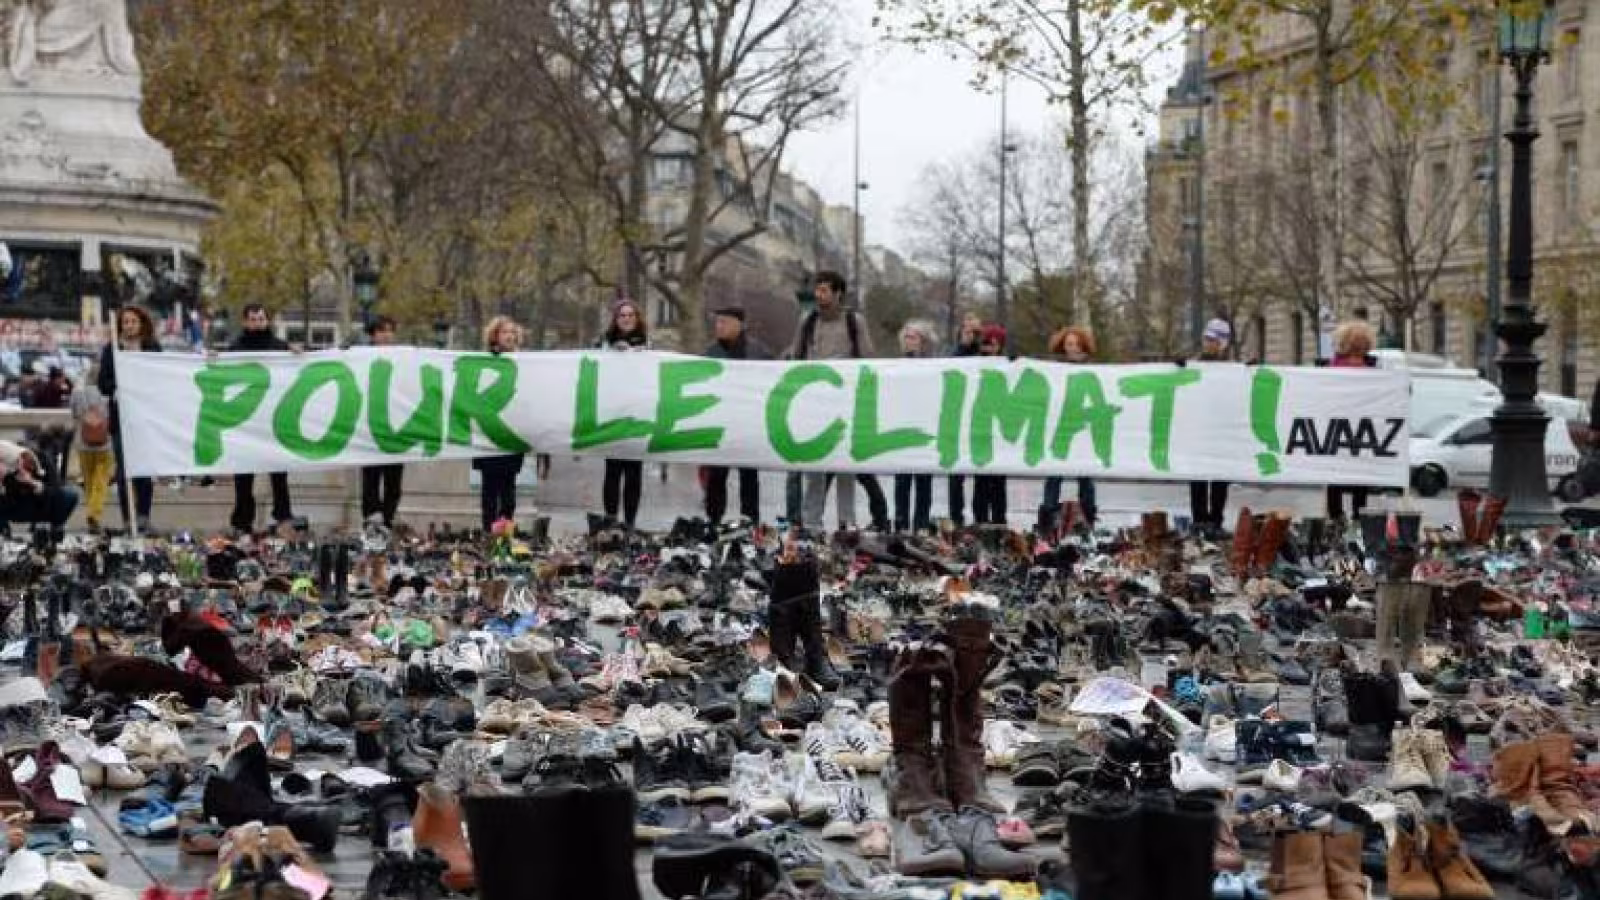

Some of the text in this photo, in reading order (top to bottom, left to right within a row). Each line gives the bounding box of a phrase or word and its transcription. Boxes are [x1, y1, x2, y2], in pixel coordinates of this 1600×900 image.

[194, 353, 1281, 475] POUR LE CLIMAT !
[1286, 418, 1404, 457] AVAAZ
